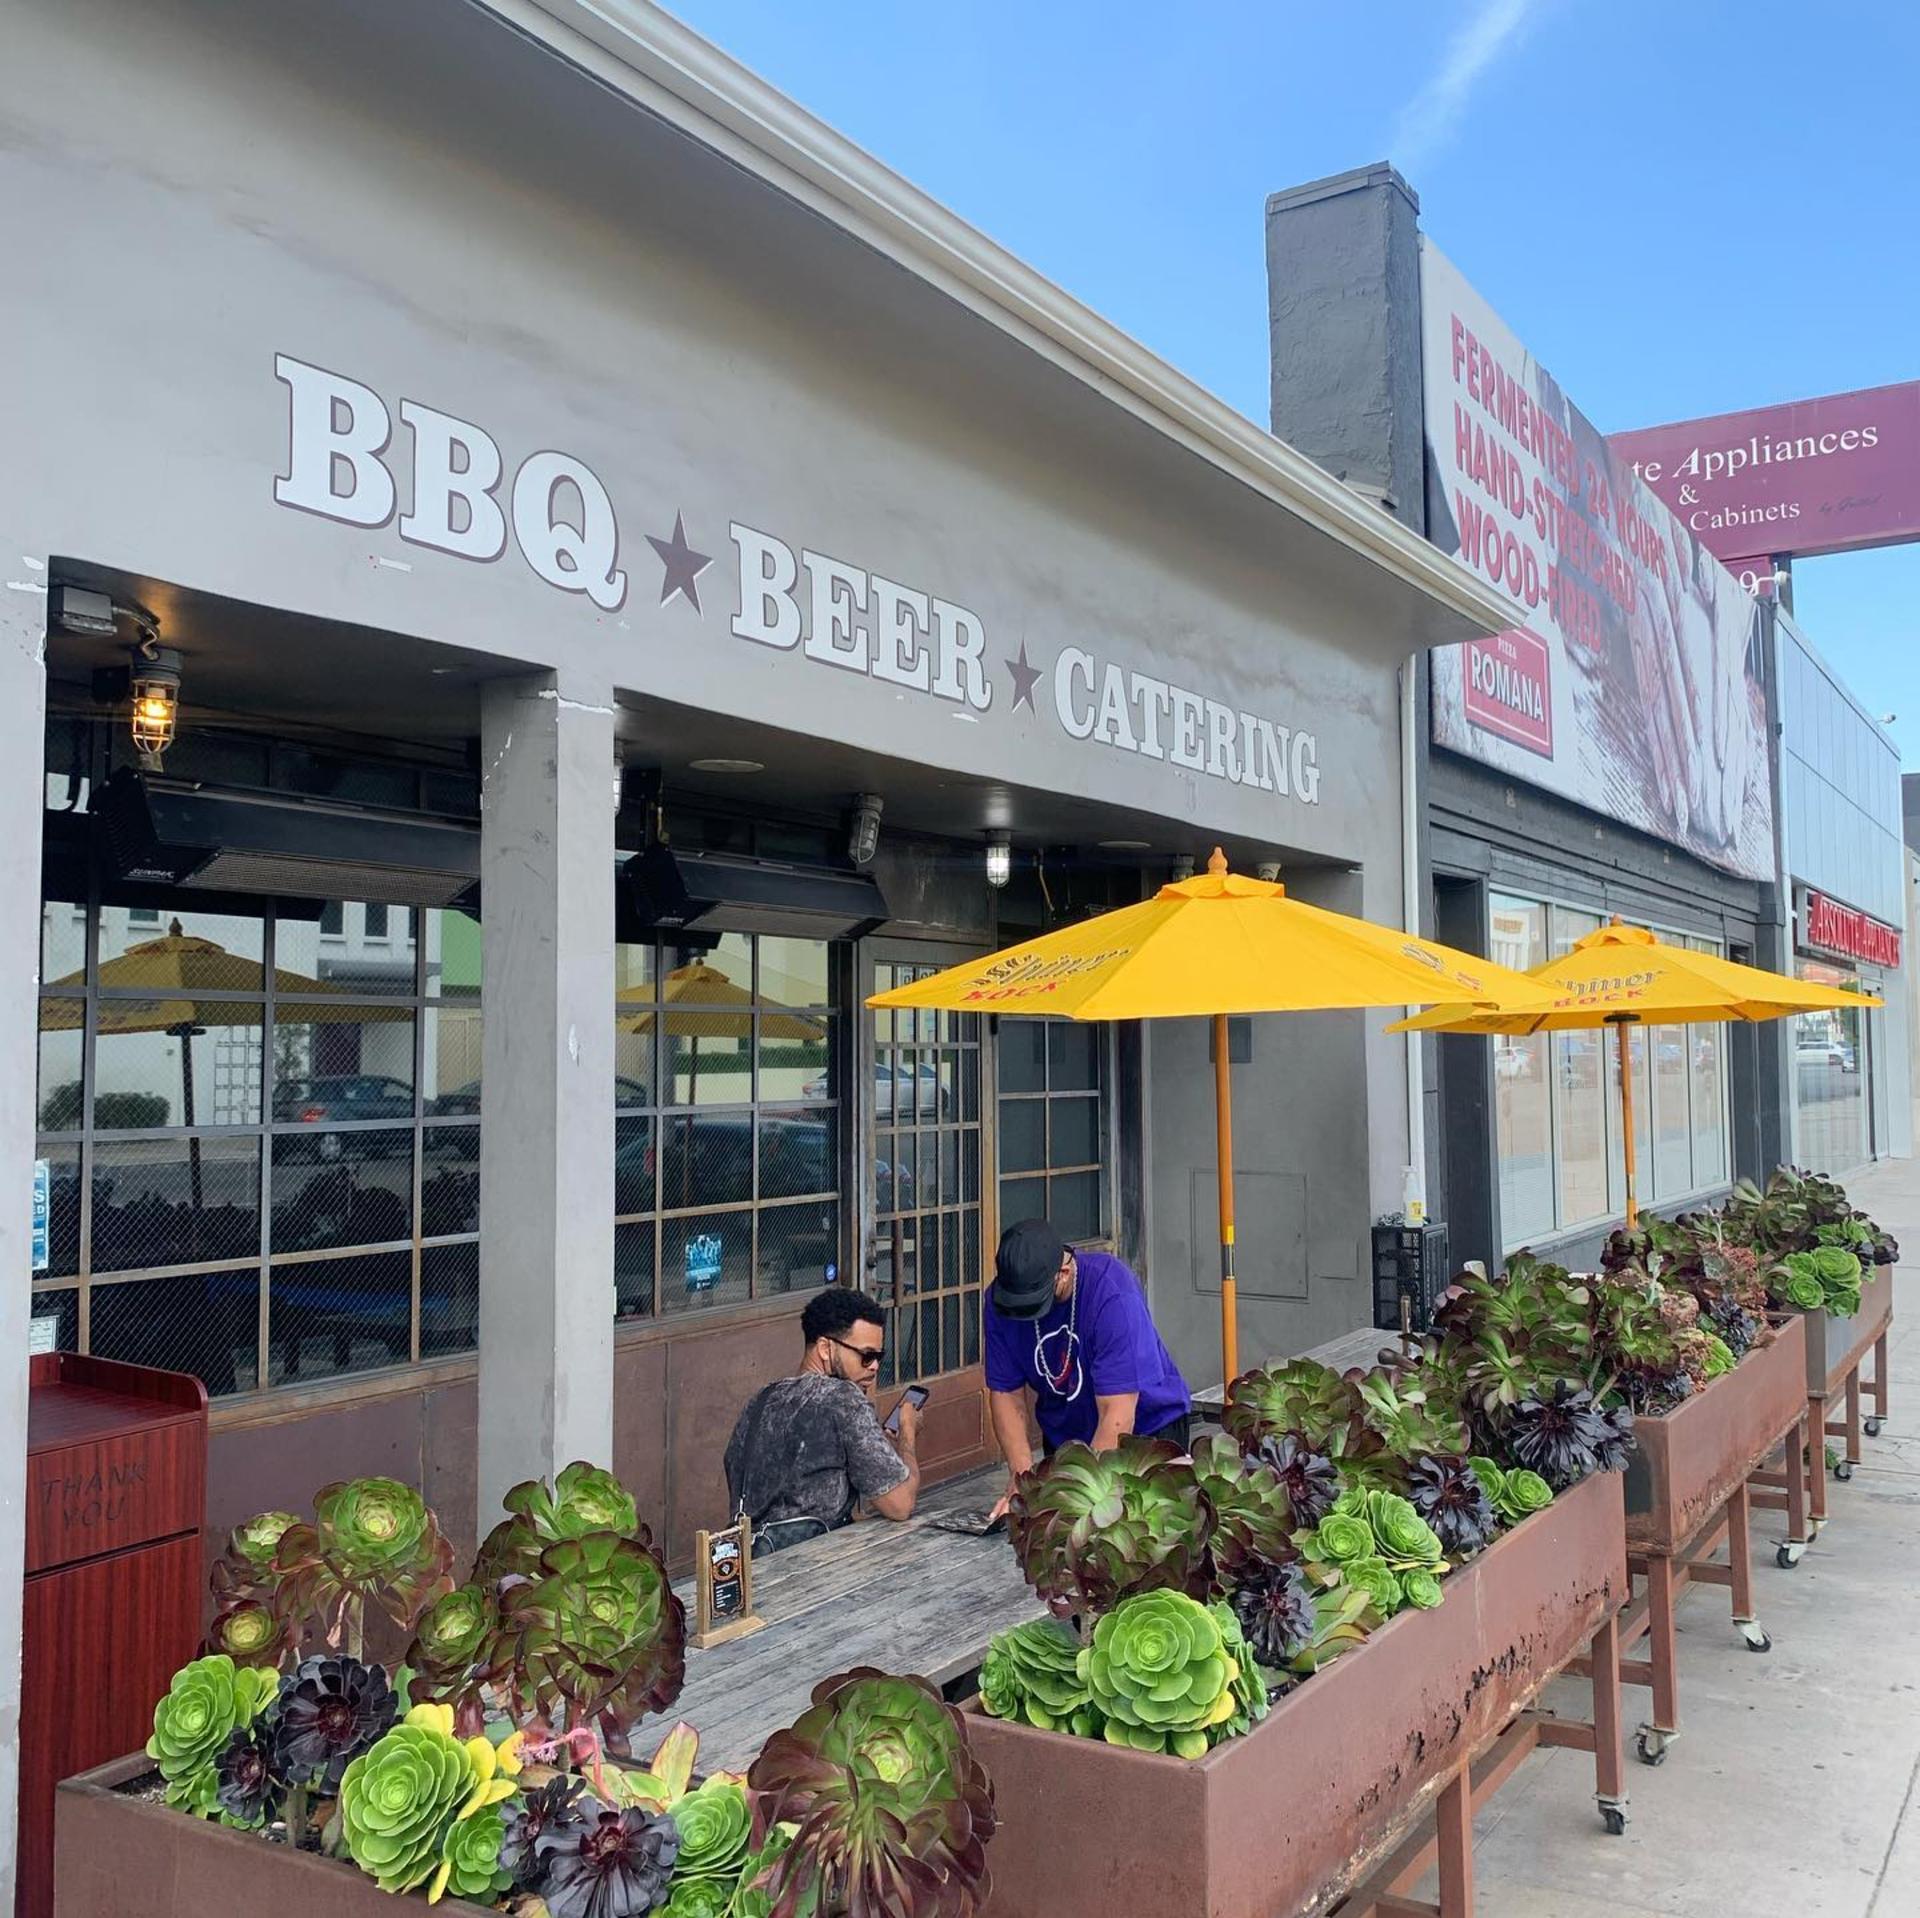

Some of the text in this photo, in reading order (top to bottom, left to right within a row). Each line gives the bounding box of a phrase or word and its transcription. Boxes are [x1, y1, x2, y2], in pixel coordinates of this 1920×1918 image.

[1451, 312, 1580, 497] FERMENTED
[1586, 459, 1610, 527] 24
[1672, 426, 1879, 480] Appliances
[1678, 484, 1700, 505] &
[1690, 502, 1801, 531] Cabinets
[273, 351, 1321, 806] BBQ BEER CATERING
[1456, 487, 1601, 653] WOOD-FIRED
[1471, 645, 1545, 722] ROMANA
[41, 1463, 146, 1505] THANK
[63, 1497, 125, 1531] YOU
